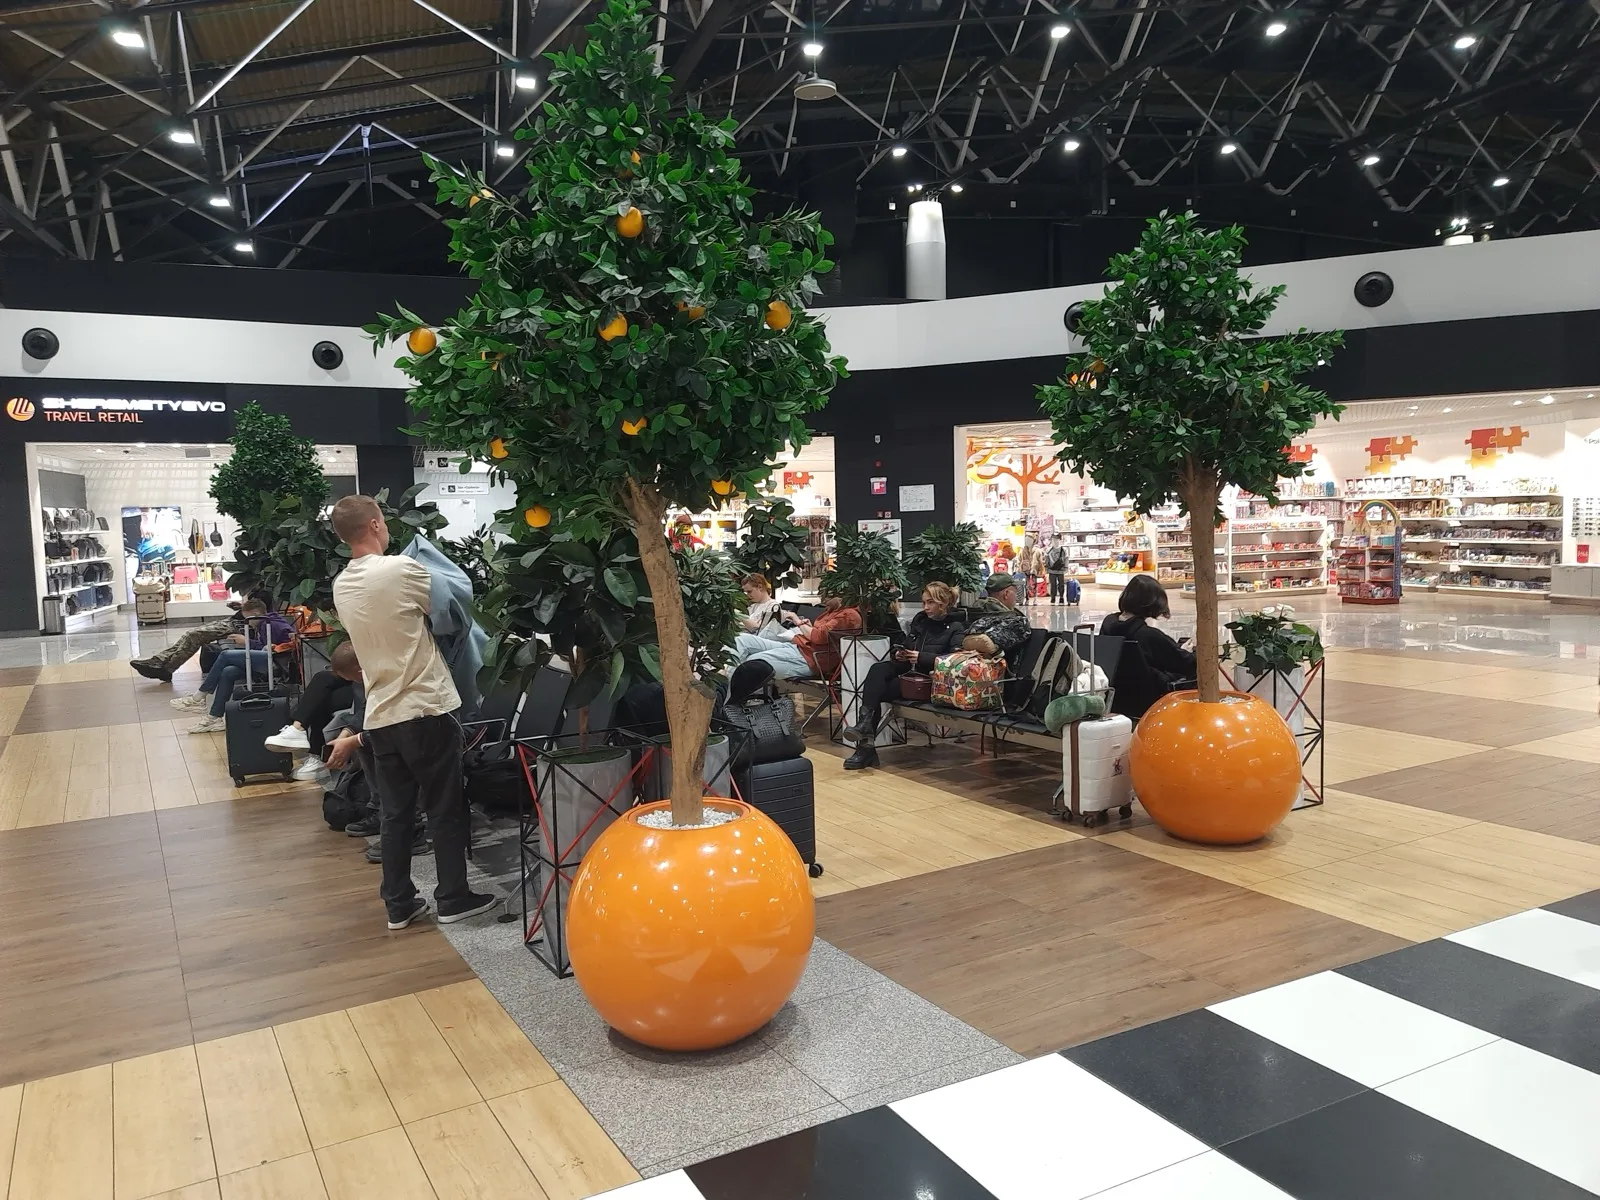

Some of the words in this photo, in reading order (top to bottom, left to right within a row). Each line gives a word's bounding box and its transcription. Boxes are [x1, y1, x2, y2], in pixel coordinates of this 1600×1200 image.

[42, 397, 227, 412] SHEREMETYEVO
[44, 411, 95, 423] TRAVEL
[98, 412, 144, 423] RETAIL
